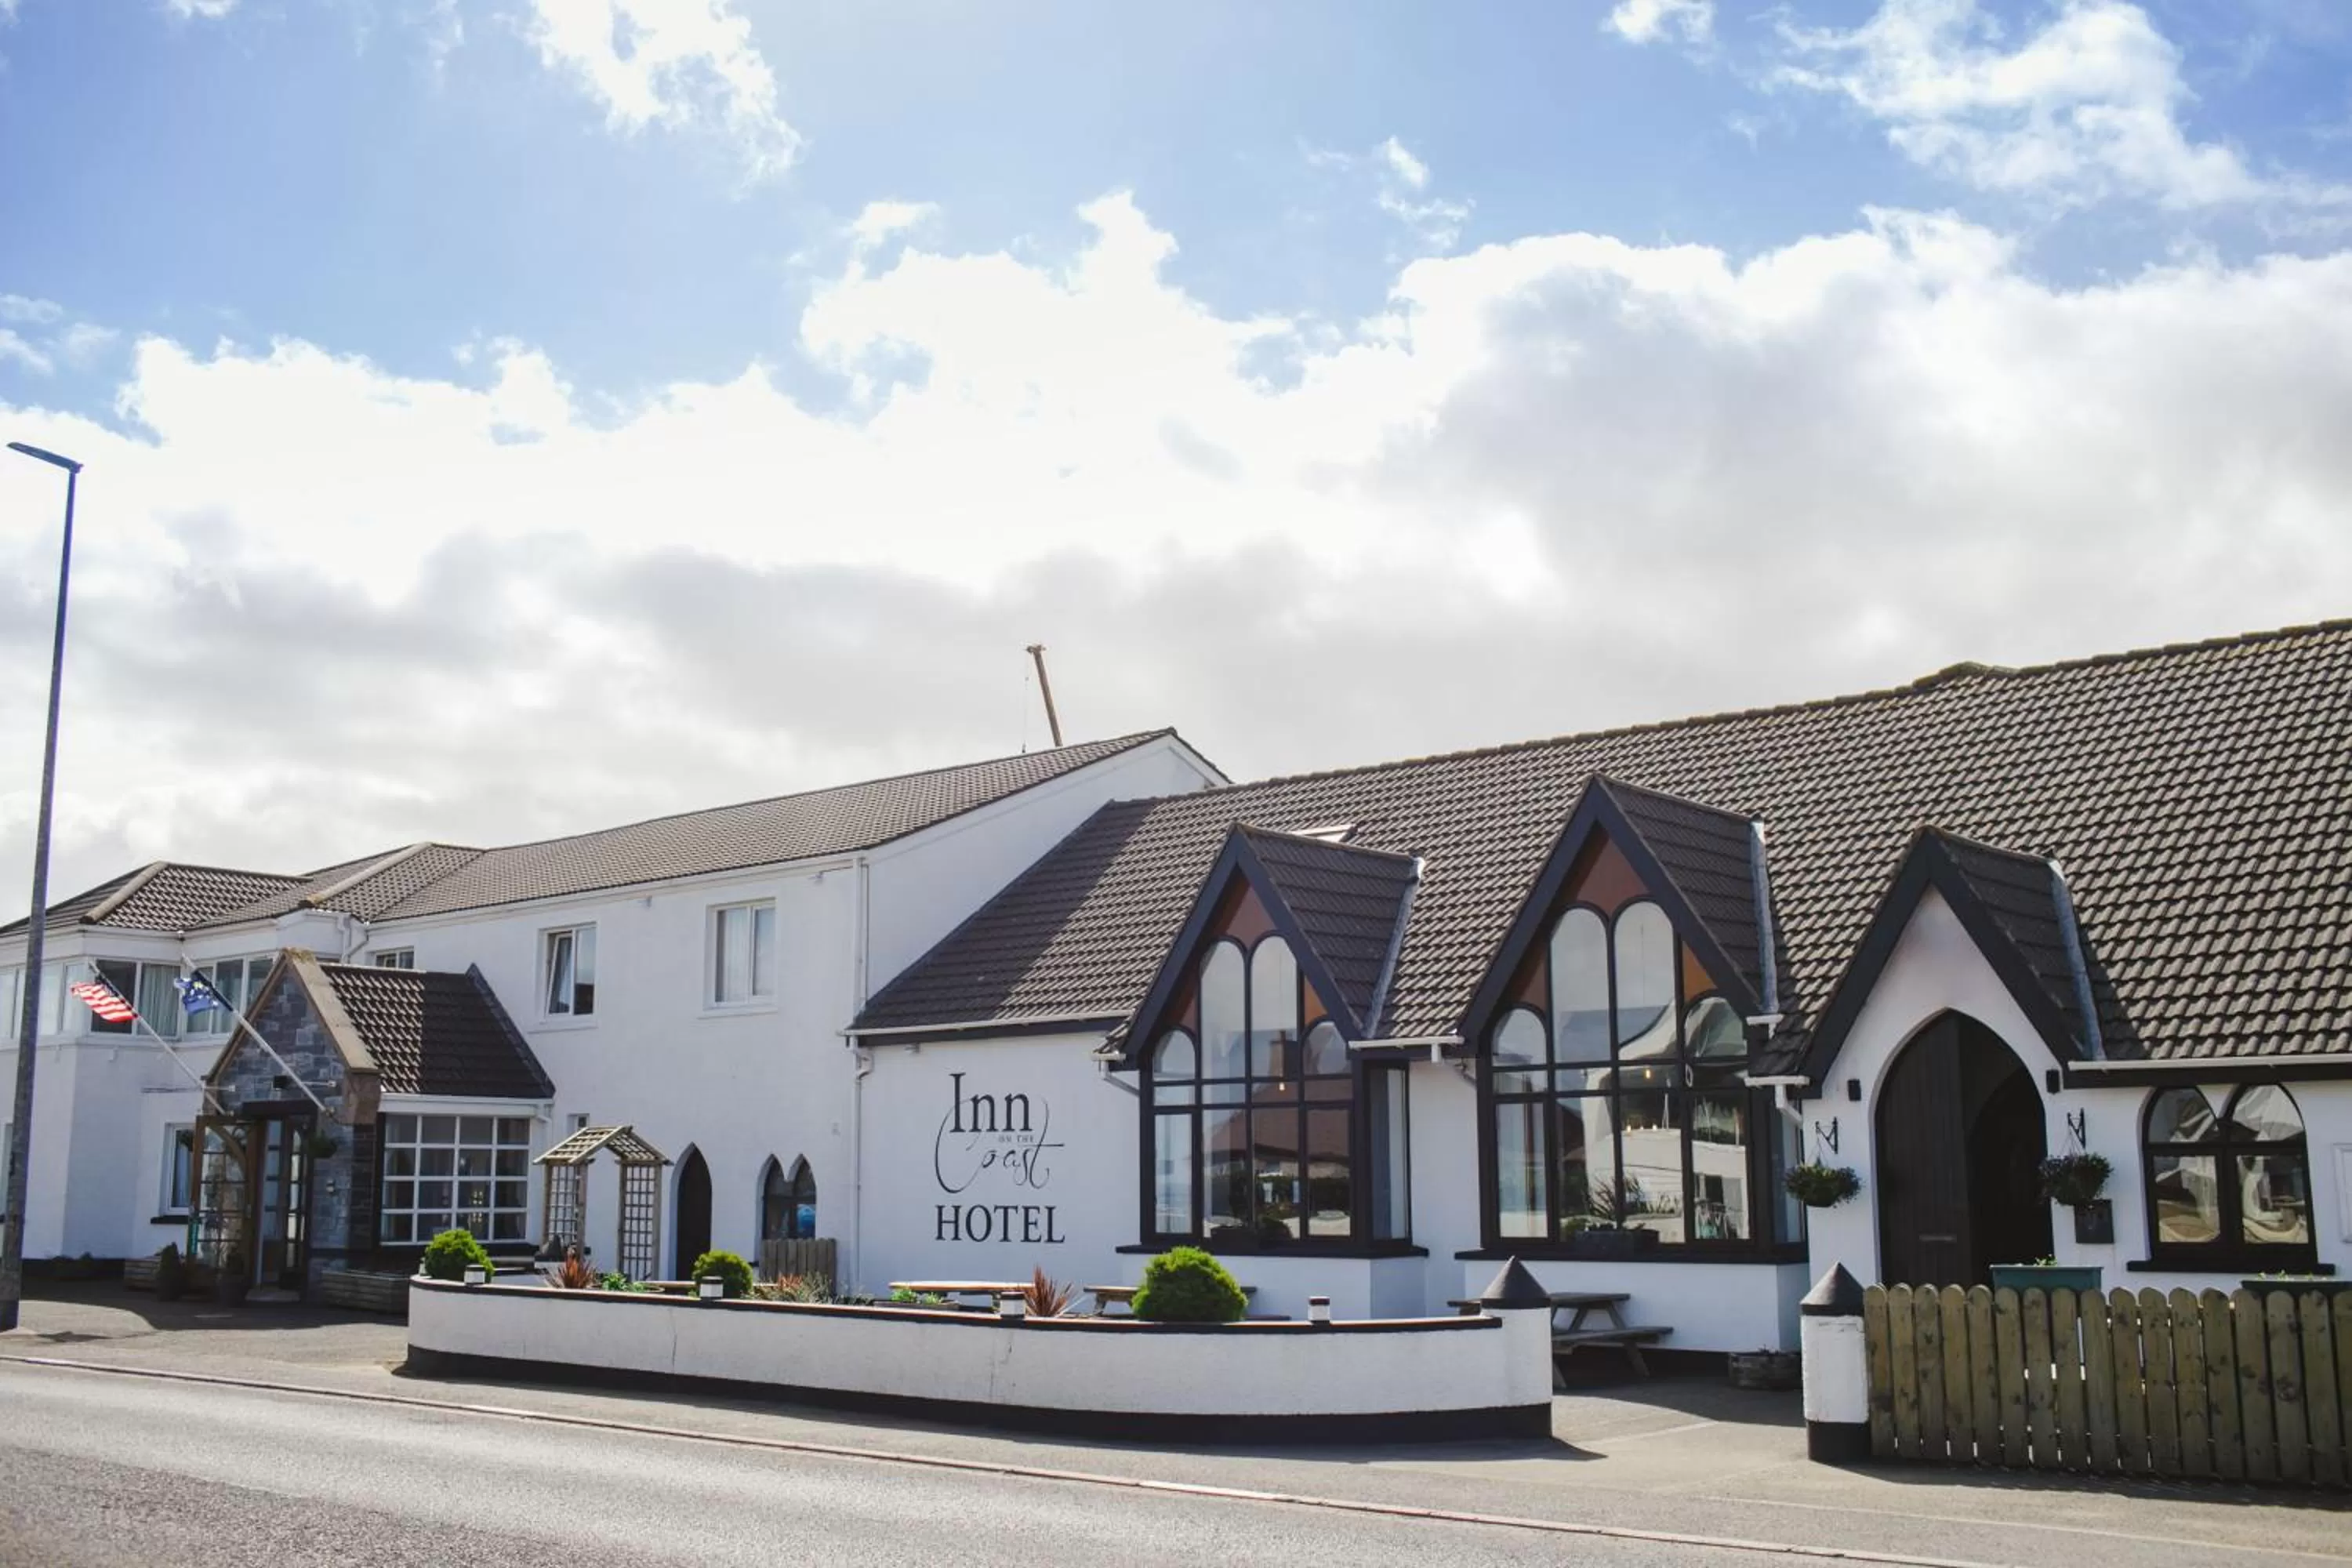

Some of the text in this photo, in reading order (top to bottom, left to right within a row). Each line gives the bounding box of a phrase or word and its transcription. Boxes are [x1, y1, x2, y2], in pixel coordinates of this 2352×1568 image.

[949, 1072, 1033, 1133] Inn
[934, 1097, 1065, 1194] Coast
[935, 1203, 1065, 1244] HOTEL
